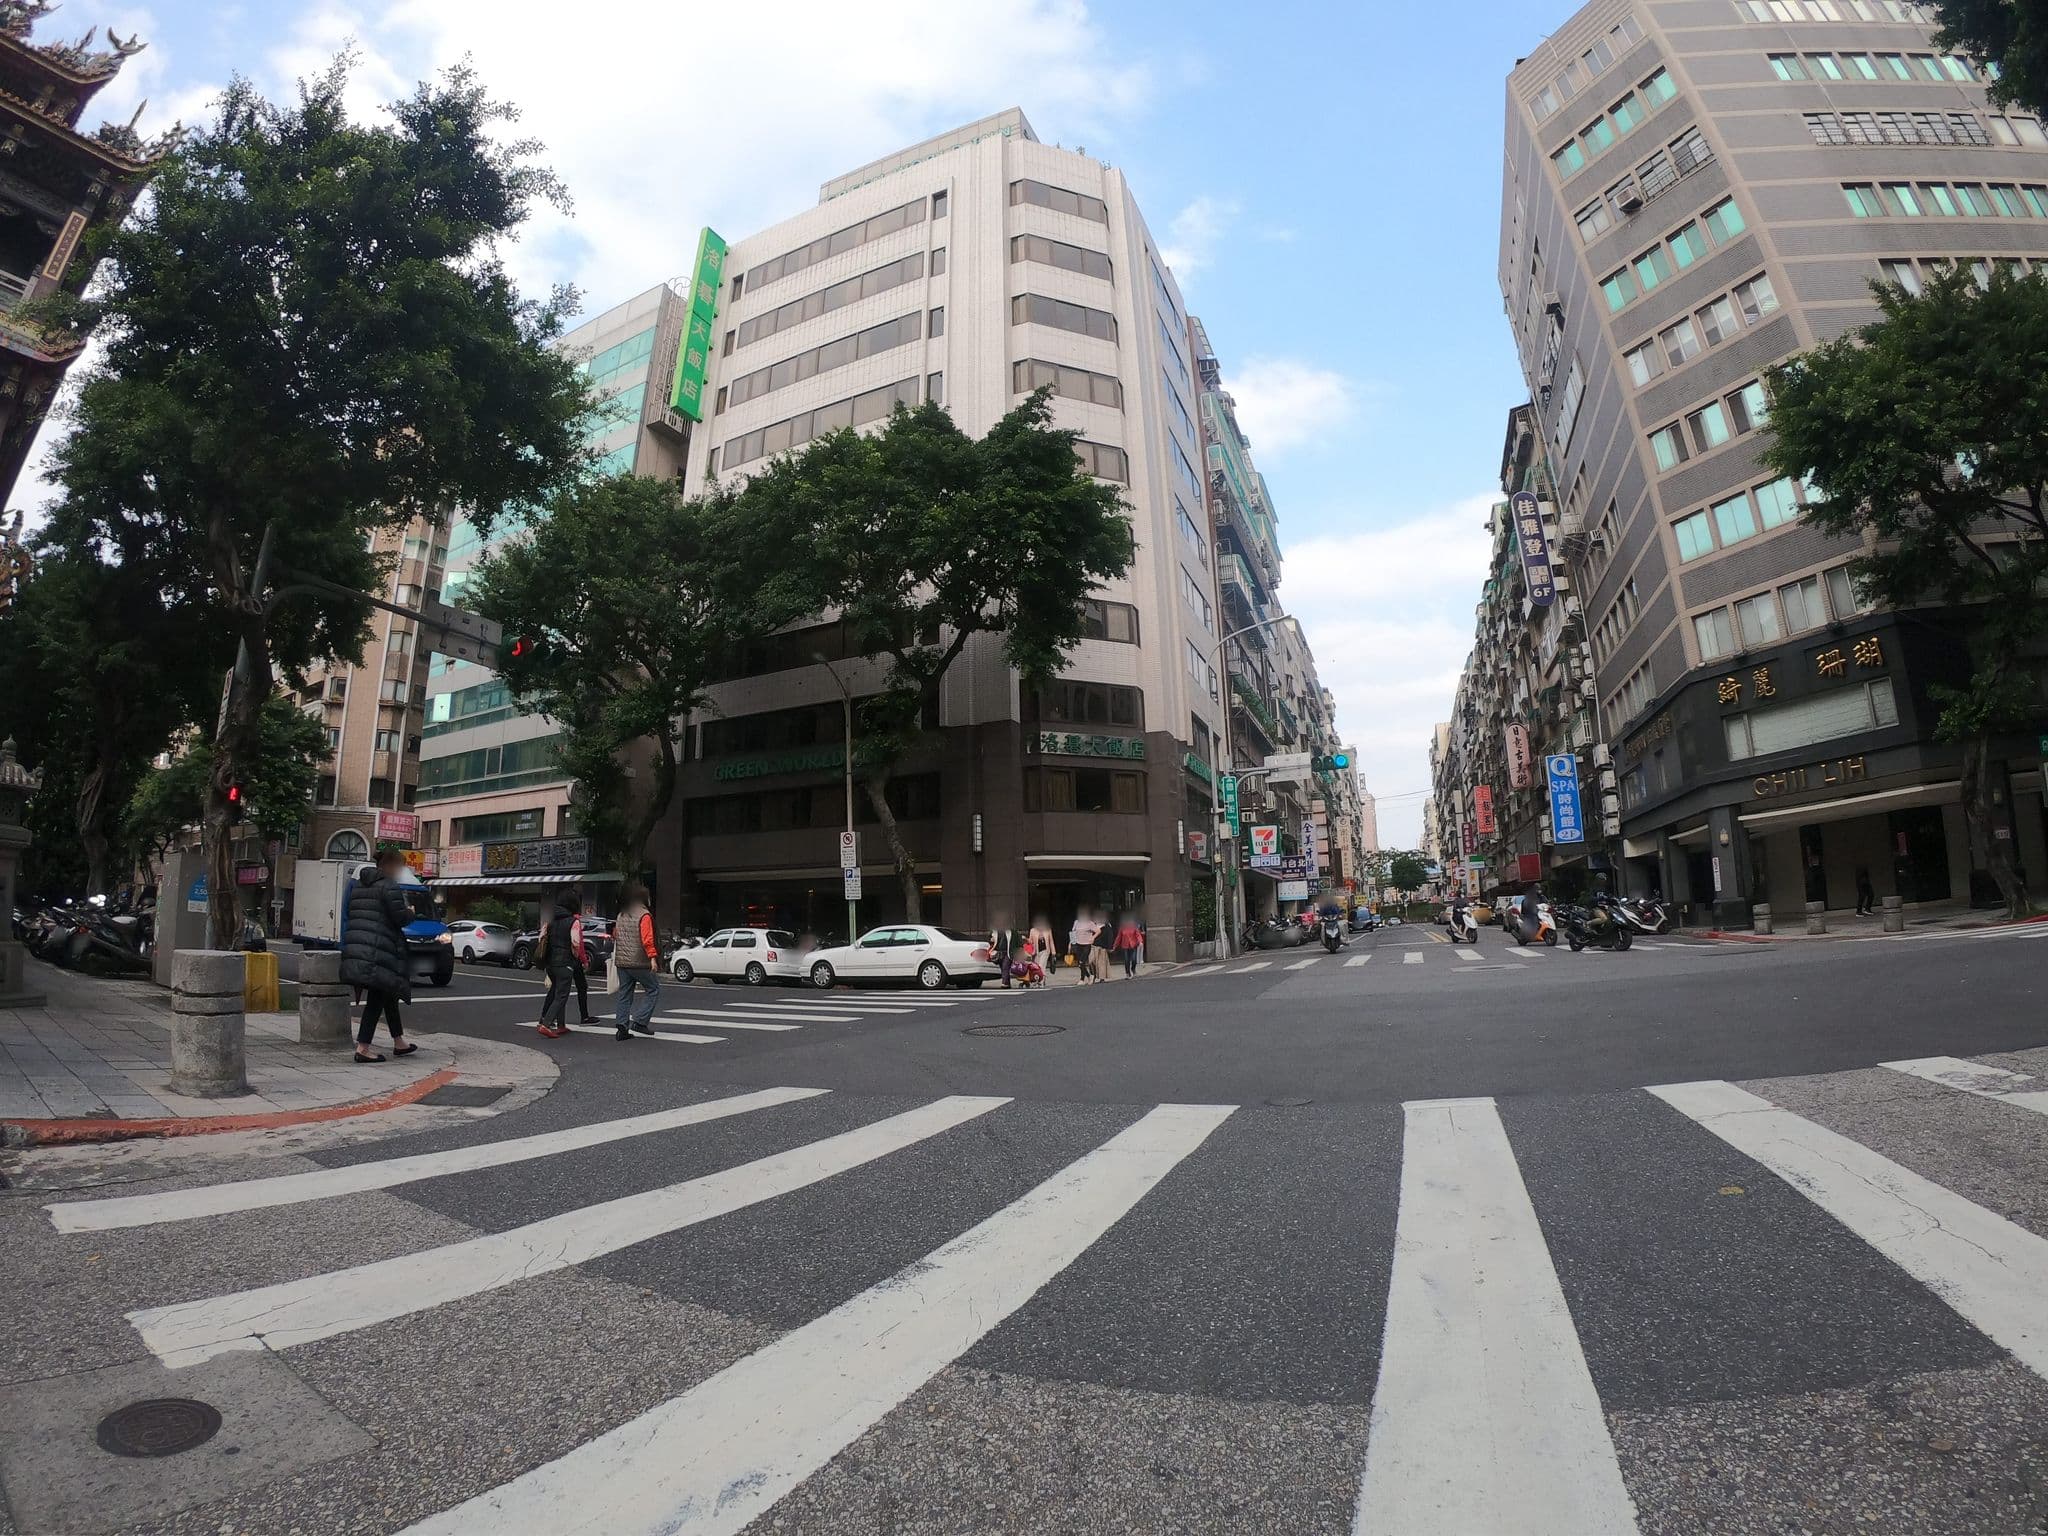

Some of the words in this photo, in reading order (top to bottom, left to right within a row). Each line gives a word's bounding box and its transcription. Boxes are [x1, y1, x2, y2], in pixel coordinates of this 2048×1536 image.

[1517, 500, 1543, 556] 佳雅登
[1533, 587, 1552, 597] 6F
[1815, 636, 1884, 678] 珊瑚
[1550, 757, 1574, 777] Q
[1820, 756, 1867, 784] LIH
[1551, 779, 1576, 793] SPA
[1557, 794, 1575, 827] 時尚館
[1561, 829, 1576, 839] 2F
